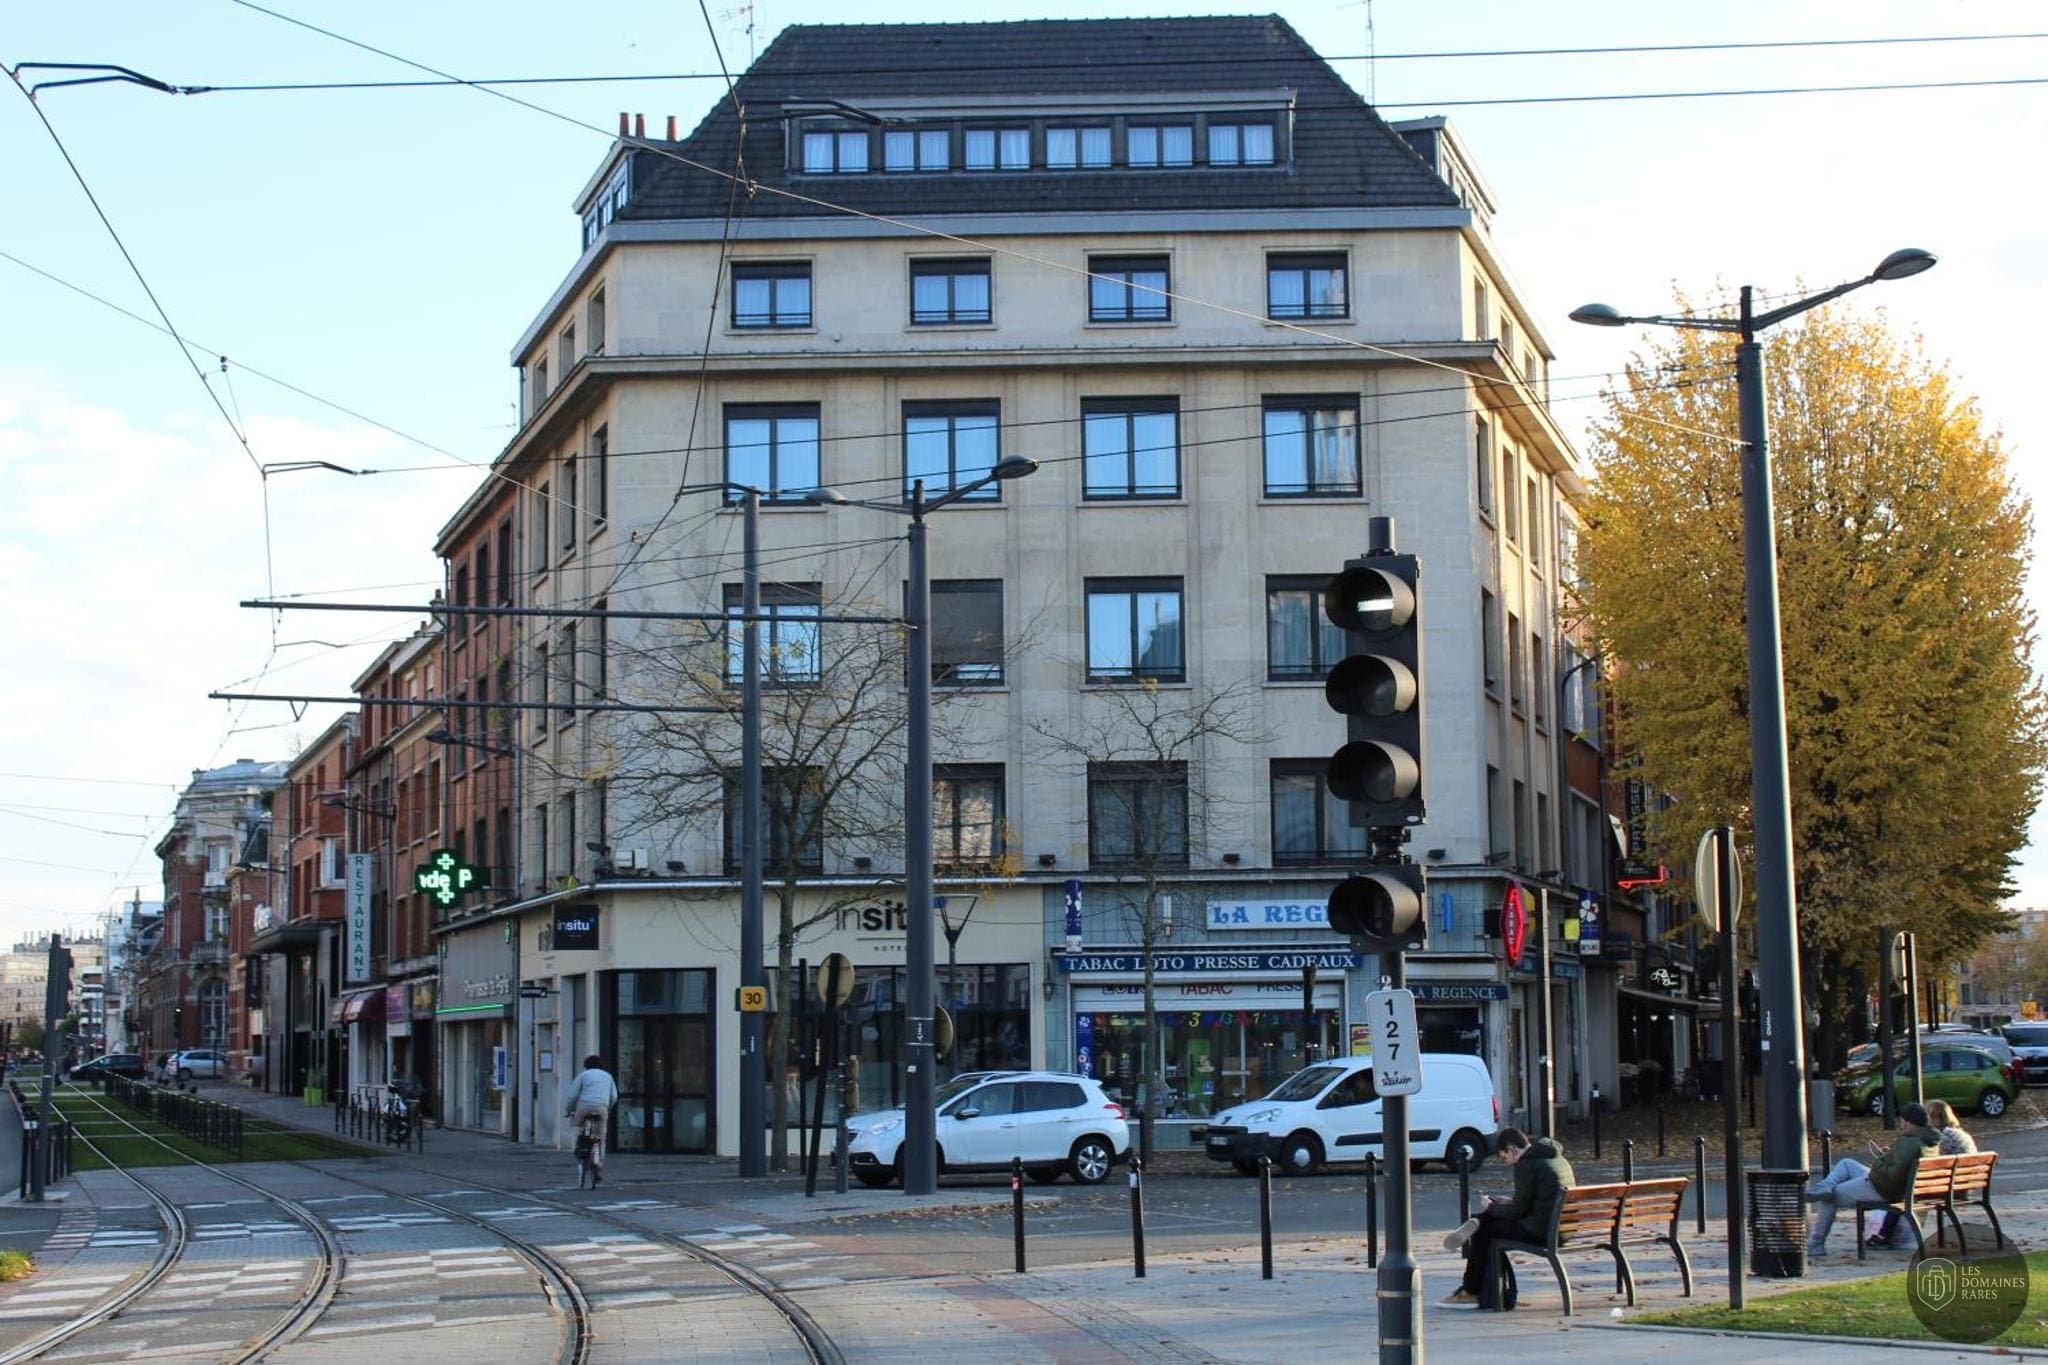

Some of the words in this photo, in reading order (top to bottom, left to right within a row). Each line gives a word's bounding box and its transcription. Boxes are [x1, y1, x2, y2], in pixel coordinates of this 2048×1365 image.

[459, 869, 472, 888] P
[354, 856, 365, 978] RESTAURANT
[834, 900, 907, 931] insit
[1214, 906, 1249, 924] LA
[1265, 905, 1330, 923] REG
[557, 919, 591, 931] insitu
[873, 944, 907, 952] HOTE
[1065, 957, 1126, 970] TABAC
[1194, 955, 1260, 969] PRESSE
[1268, 954, 1355, 968] CADEAUX
[744, 992, 762, 1005] 30
[1432, 985, 1497, 999] REGENCE
